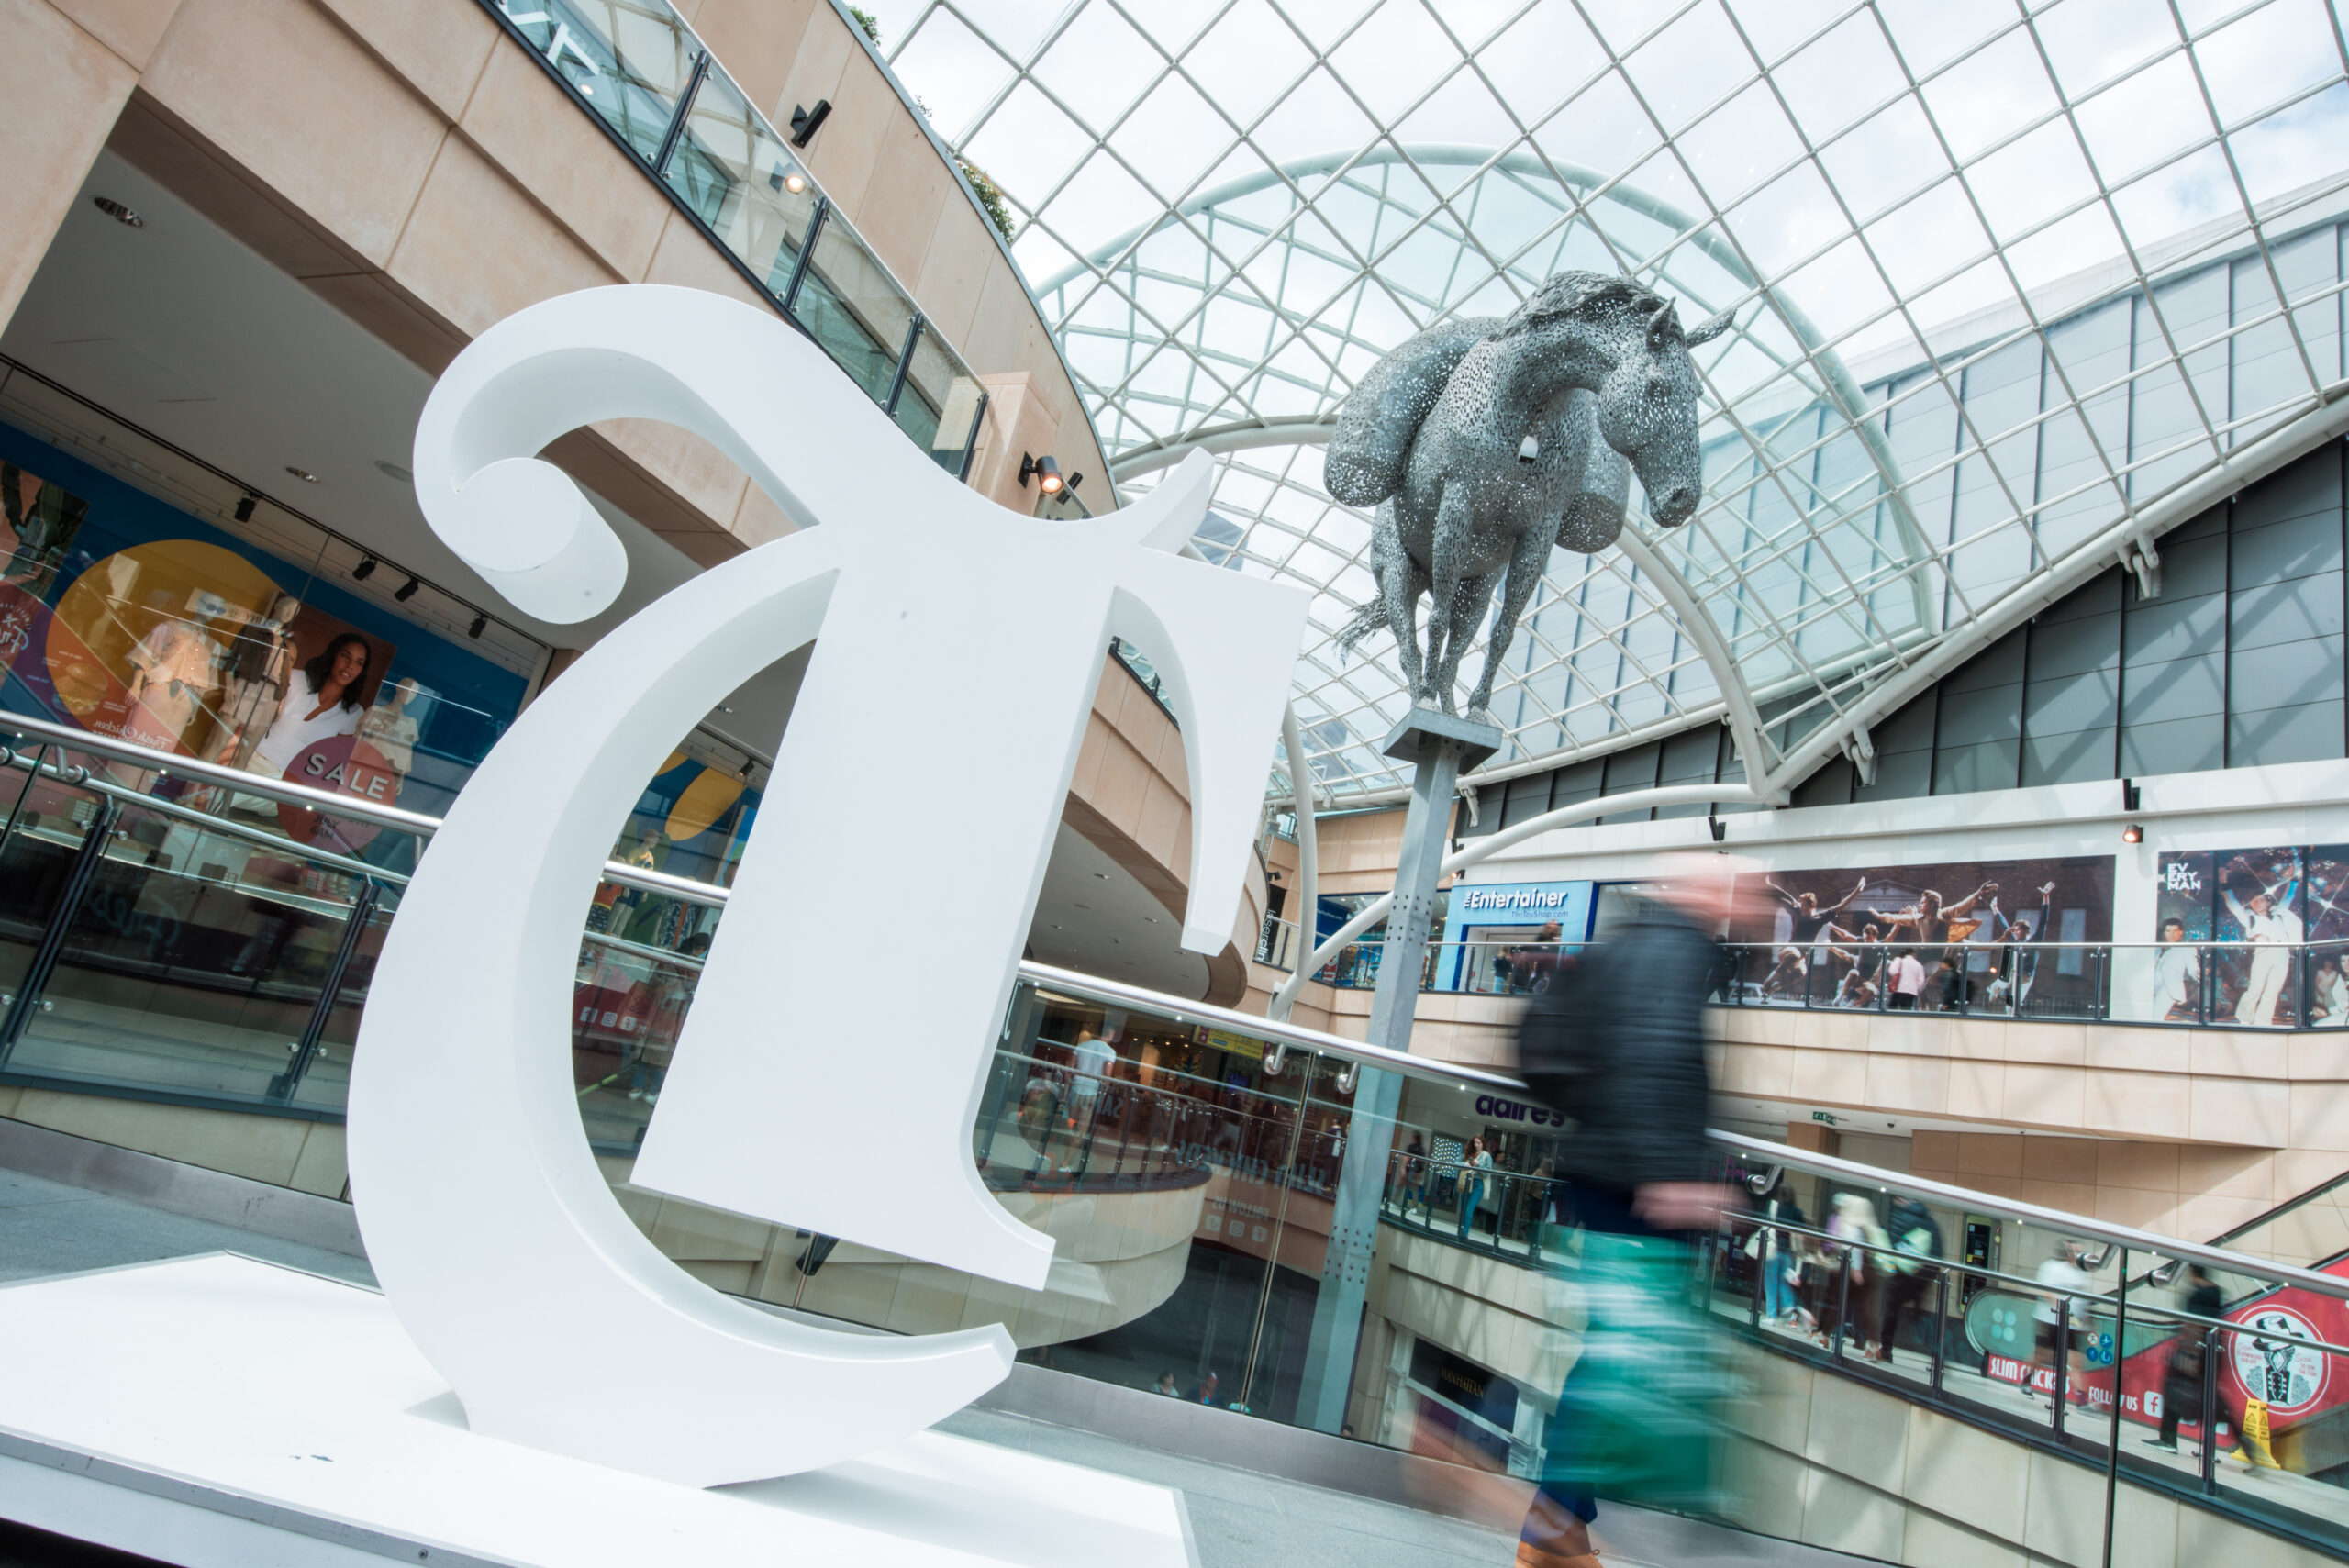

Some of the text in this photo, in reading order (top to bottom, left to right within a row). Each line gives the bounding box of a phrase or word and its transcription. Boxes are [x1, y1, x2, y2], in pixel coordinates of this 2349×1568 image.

[304, 752, 390, 800] SALE
[2166, 862, 2189, 873] EV
[2166, 872, 2199, 882] ERY
[2166, 880, 2202, 891] MAN
[1470, 887, 1569, 909] Entertainer
[1475, 1094, 1566, 1129] claires
[1989, 1356, 2019, 1381] SLIM
[1439, 1365, 1485, 1399] MANHATTAN
[2126, 1396, 2139, 1412] US
